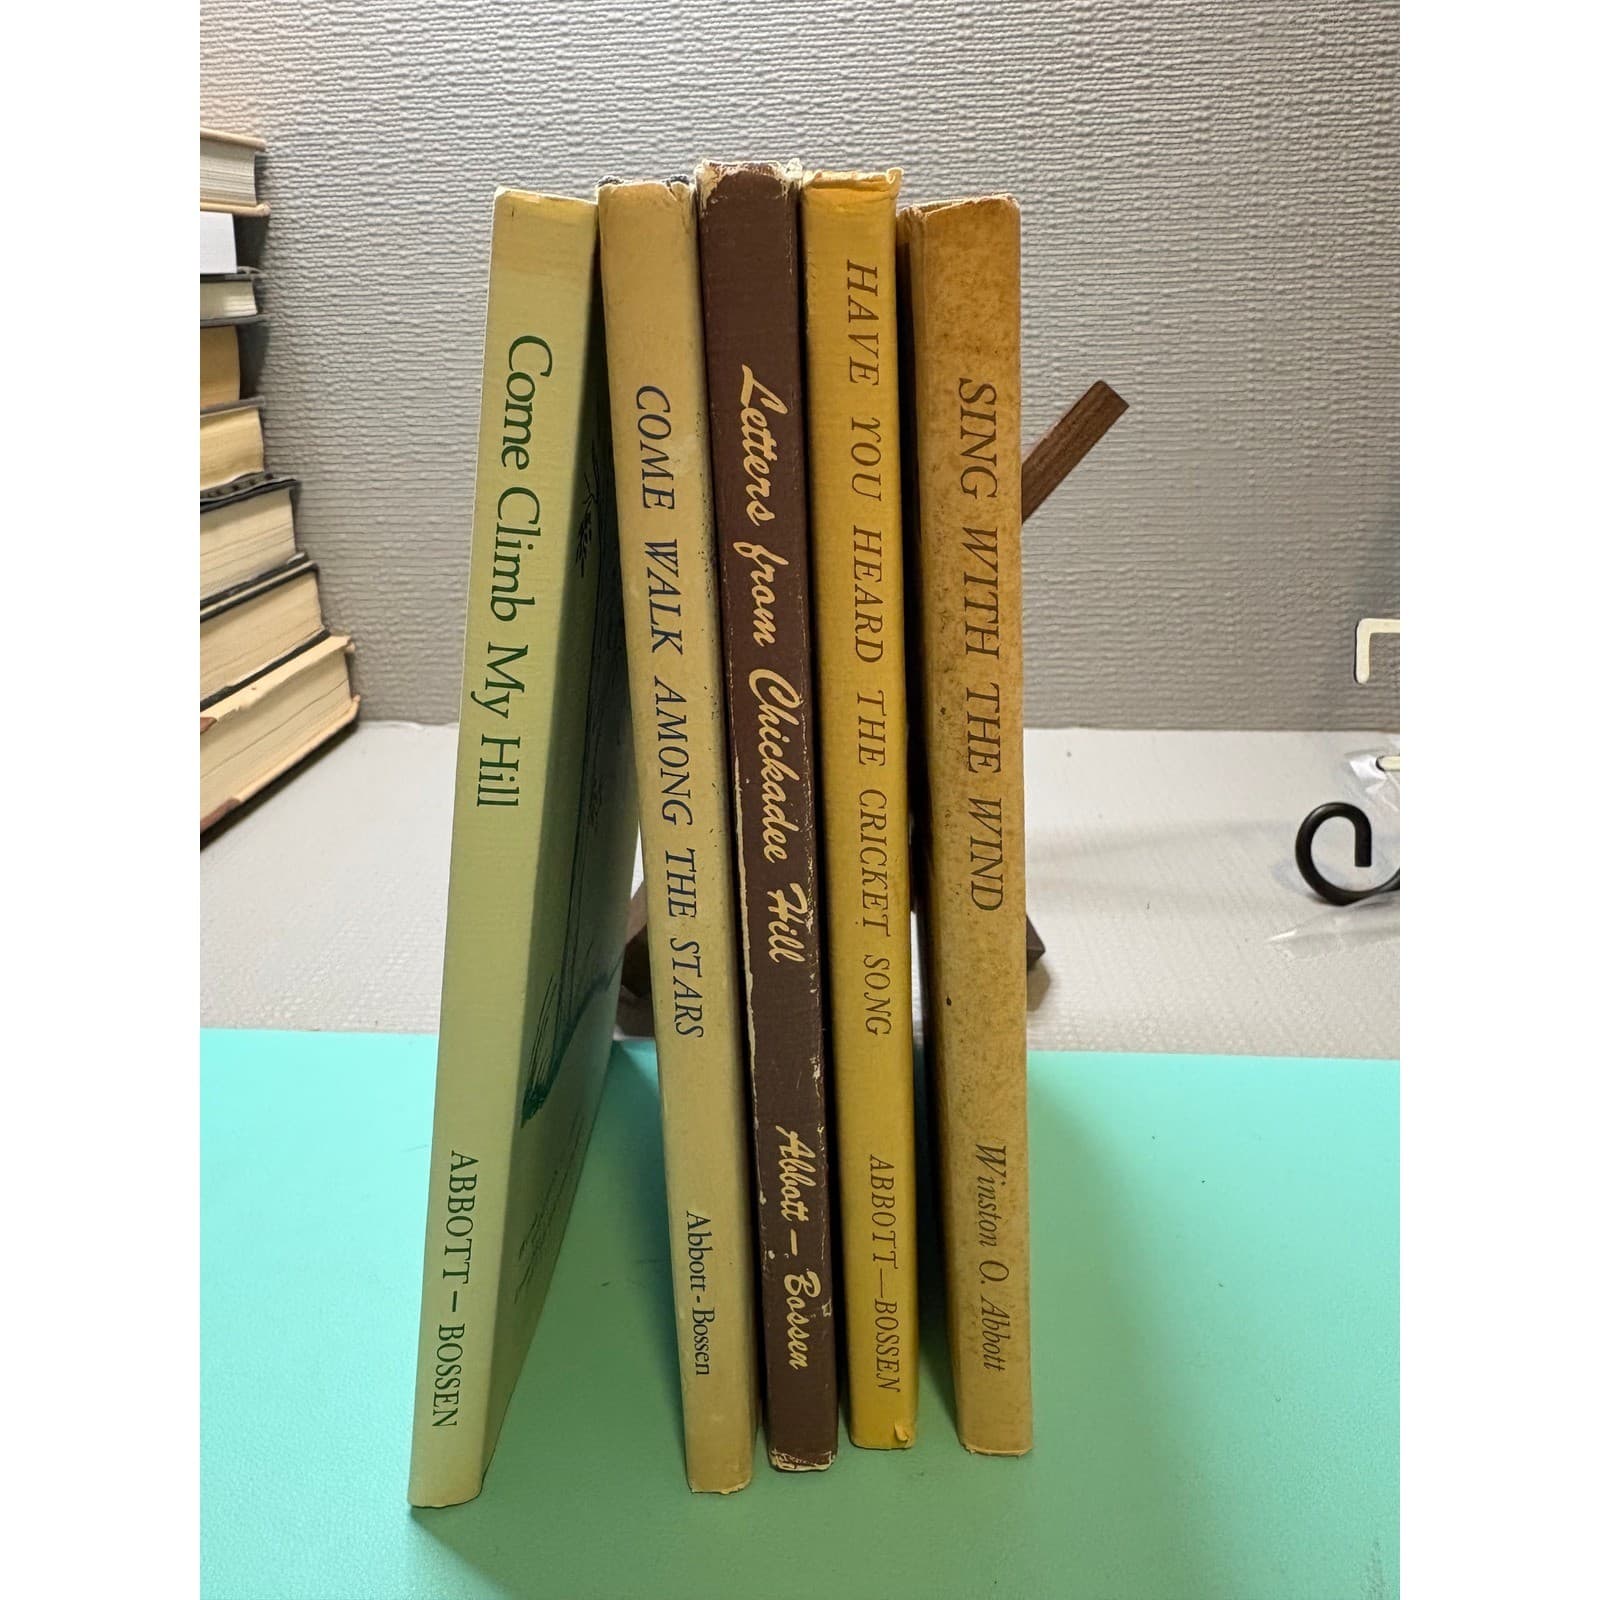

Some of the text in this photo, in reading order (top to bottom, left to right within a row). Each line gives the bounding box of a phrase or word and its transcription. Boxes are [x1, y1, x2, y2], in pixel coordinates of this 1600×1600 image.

[470, 335, 553, 807] Come Climb My Hill
[636, 385, 704, 1038] COME WALK AMONG THE STARS
[732, 364, 808, 963] Letters from Chickadee Hill
[846, 259, 892, 1036] HAVE YOU HEARD THE CRICKET SONG
[958, 378, 1004, 912] SING WITH THE WIND
[442, 1150, 479, 1284] ABBOTT
[775, 1125, 816, 1222] Abbott
[784, 1271, 821, 1370] Bossen
[975, 1144, 1010, 1372] Winston O. Abbott
[432, 1323, 465, 1427] BOSSEN
